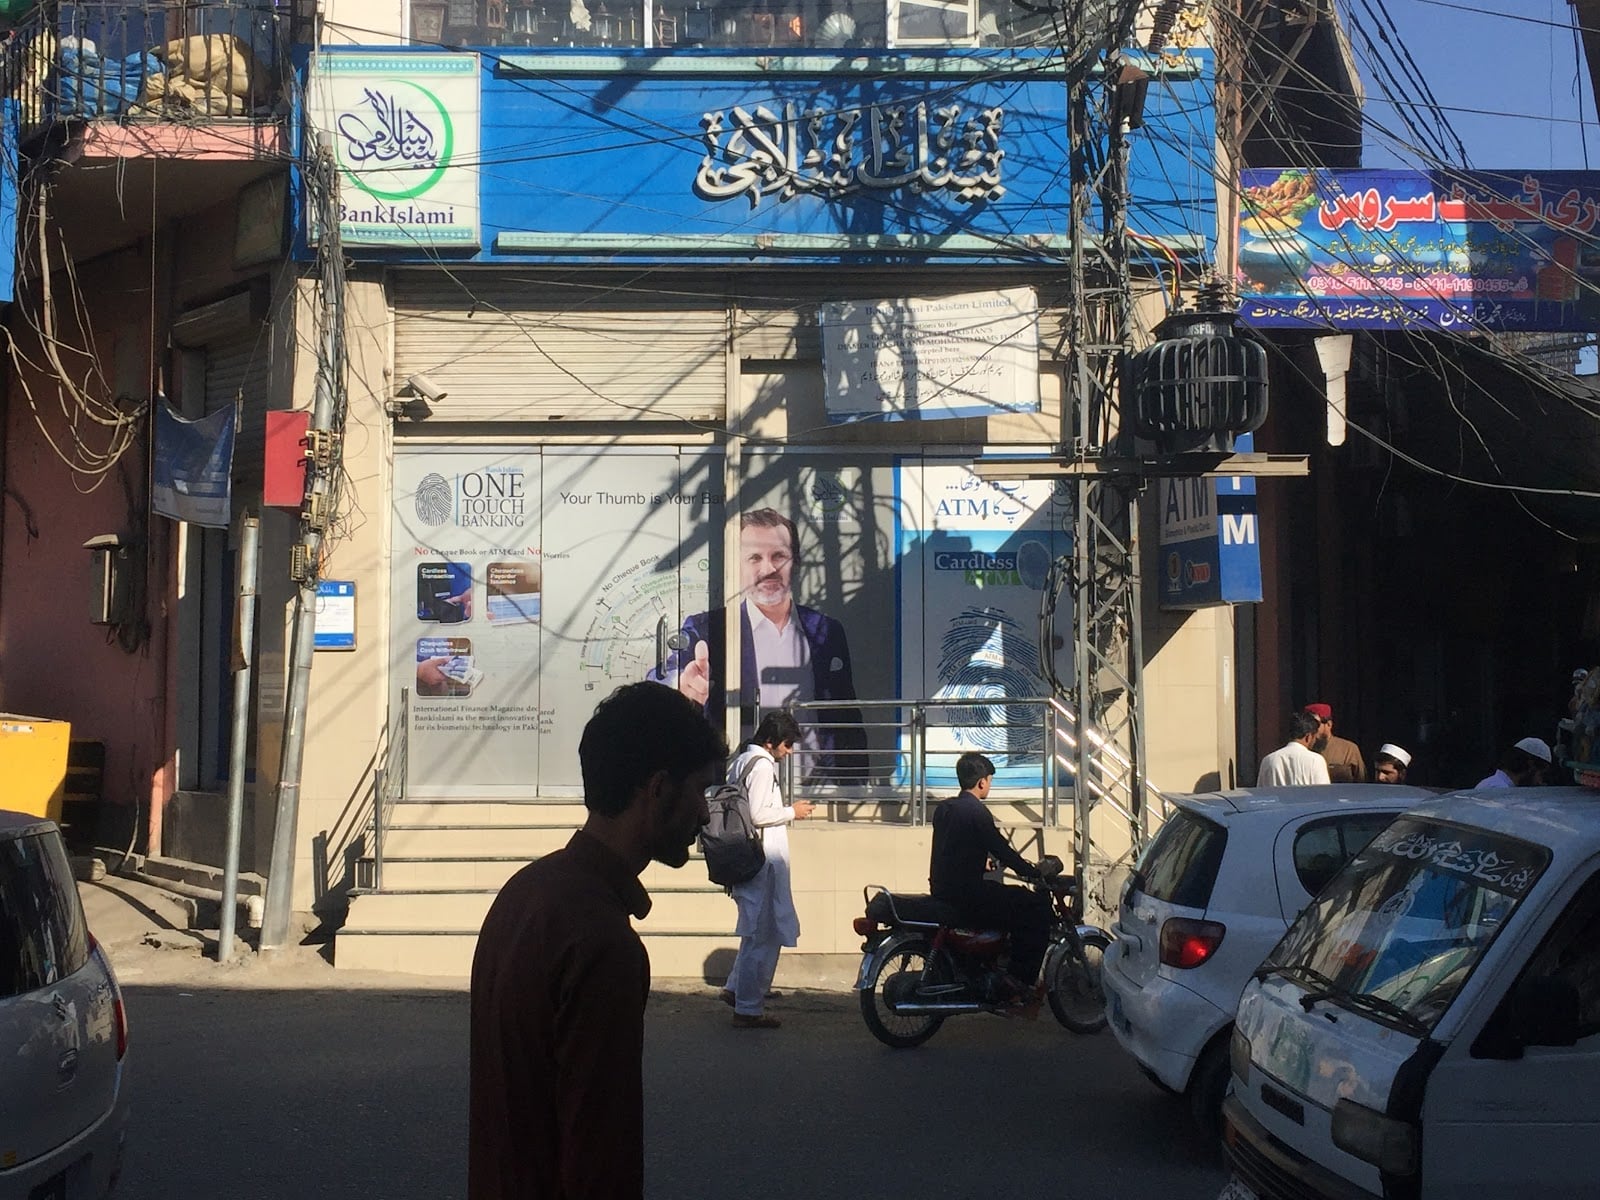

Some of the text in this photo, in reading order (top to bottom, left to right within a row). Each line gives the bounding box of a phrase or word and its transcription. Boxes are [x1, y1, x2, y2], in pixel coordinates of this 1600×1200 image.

[1318, 188, 1436, 233] سروس
[926, 303, 969, 313] Pakistan
[972, 298, 1012, 309] Limited
[462, 472, 525, 498] ONE
[560, 491, 592, 504] Your
[596, 491, 646, 504] Thumb
[650, 491, 662, 504] is
[665, 491, 697, 504] Your
[1165, 477, 1209, 524] ATM
[462, 499, 525, 515] TOUCH
[935, 498, 989, 516] ATM
[462, 515, 525, 528] BANKING
[414, 547, 429, 555] No
[459, 548, 477, 556] Book
[527, 547, 541, 555] No
[936, 553, 1014, 570] Cardless
[602, 583, 614, 593] No
[612, 563, 640, 584] Cheque
[639, 554, 661, 567] Book
[413, 705, 459, 713] International
[461, 705, 488, 713] Finance
[490, 705, 525, 714] Magazine
[466, 714, 477, 722] the
[497, 714, 535, 722] innovative
[414, 723, 425, 731] for
[472, 723, 511, 732] technology
[513, 723, 520, 731] in
